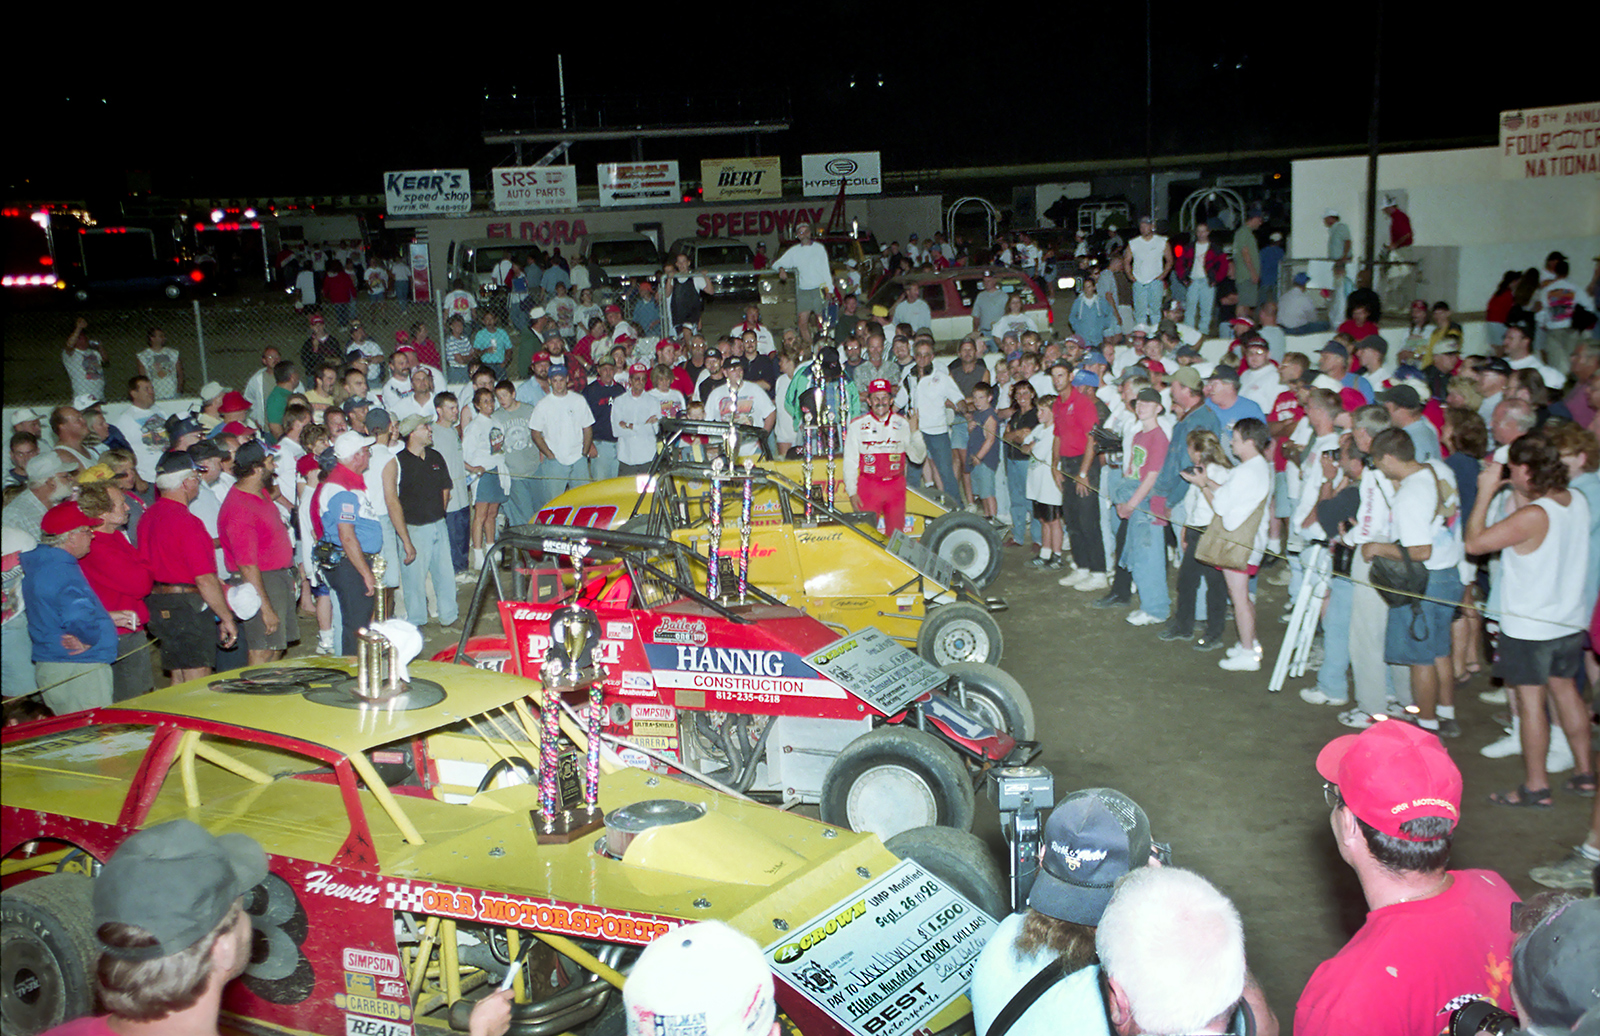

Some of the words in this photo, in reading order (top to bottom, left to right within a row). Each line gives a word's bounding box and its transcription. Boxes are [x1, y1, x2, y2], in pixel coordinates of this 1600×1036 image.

[1506, 133, 1551, 156] FOUR
[387, 172, 461, 197] KEAR'S
[501, 172, 537, 187] SRS
[717, 170, 766, 187] BERT
[404, 191, 438, 204] speed
[444, 190, 469, 203] shop
[507, 190, 530, 198] AUTO
[536, 188, 566, 197] PARTS
[486, 220, 588, 246] ELDORA
[696, 208, 824, 239] SPEEDWAY
[798, 532, 844, 543] Hewitt
[514, 609, 552, 621] Hew
[656, 618, 705, 634] Bailey's
[676, 646, 784, 676] HANNIG
[694, 676, 803, 692] CONSTRUCTION
[716, 692, 780, 705] 812-235-6218
[635, 708, 671, 718] SIMPSON
[630, 738, 666, 748] CARRERA
[1391, 803, 1409, 815] ORR
[304, 870, 380, 904] Hewitt
[868, 890, 890, 907] UMP
[888, 868, 924, 894] Modified
[422, 890, 474, 918] ORR
[480, 895, 671, 943] MOTORSPORTS
[875, 908, 902, 928] Sept.
[900, 896, 916, 910] 26
[800, 899, 866, 951] CROWN
[348, 952, 394, 972] SIMPSON
[846, 990, 882, 1018] Fifteen
[878, 963, 918, 995] Hundred
[920, 938, 950, 964] 00/100
[952, 916, 987, 944] DOLLARS
[350, 997, 396, 1016] CARRERA
[826, 991, 846, 1009] PAY
[844, 984, 859, 997] TO
[862, 982, 928, 1034] BEST
[876, 994, 940, 1036] Motorsports
